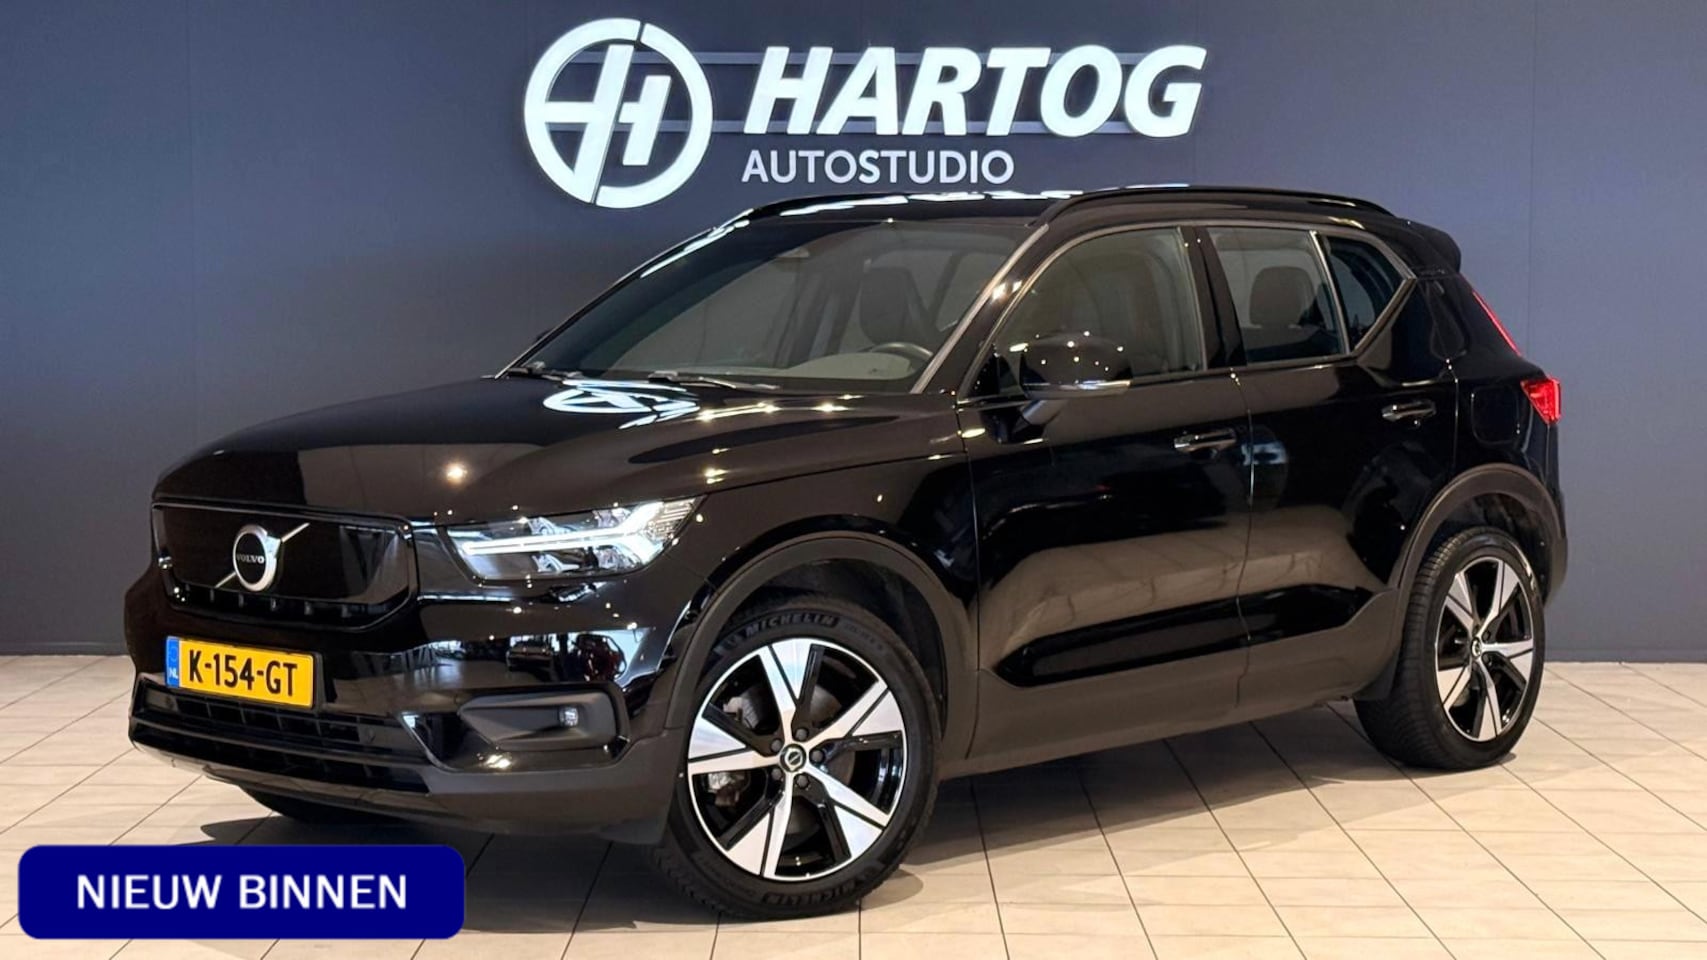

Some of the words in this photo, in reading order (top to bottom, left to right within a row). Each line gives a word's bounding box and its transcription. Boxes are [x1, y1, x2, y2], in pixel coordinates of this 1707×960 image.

[743, 44, 1207, 138] HARTOG
[741, 149, 1015, 185] AUTOSTUDIO
[236, 553, 265, 564] VOLVO
[745, 613, 836, 636] MICHELIN
[169, 667, 179, 680] NL
[189, 649, 298, 697] K-154-GT
